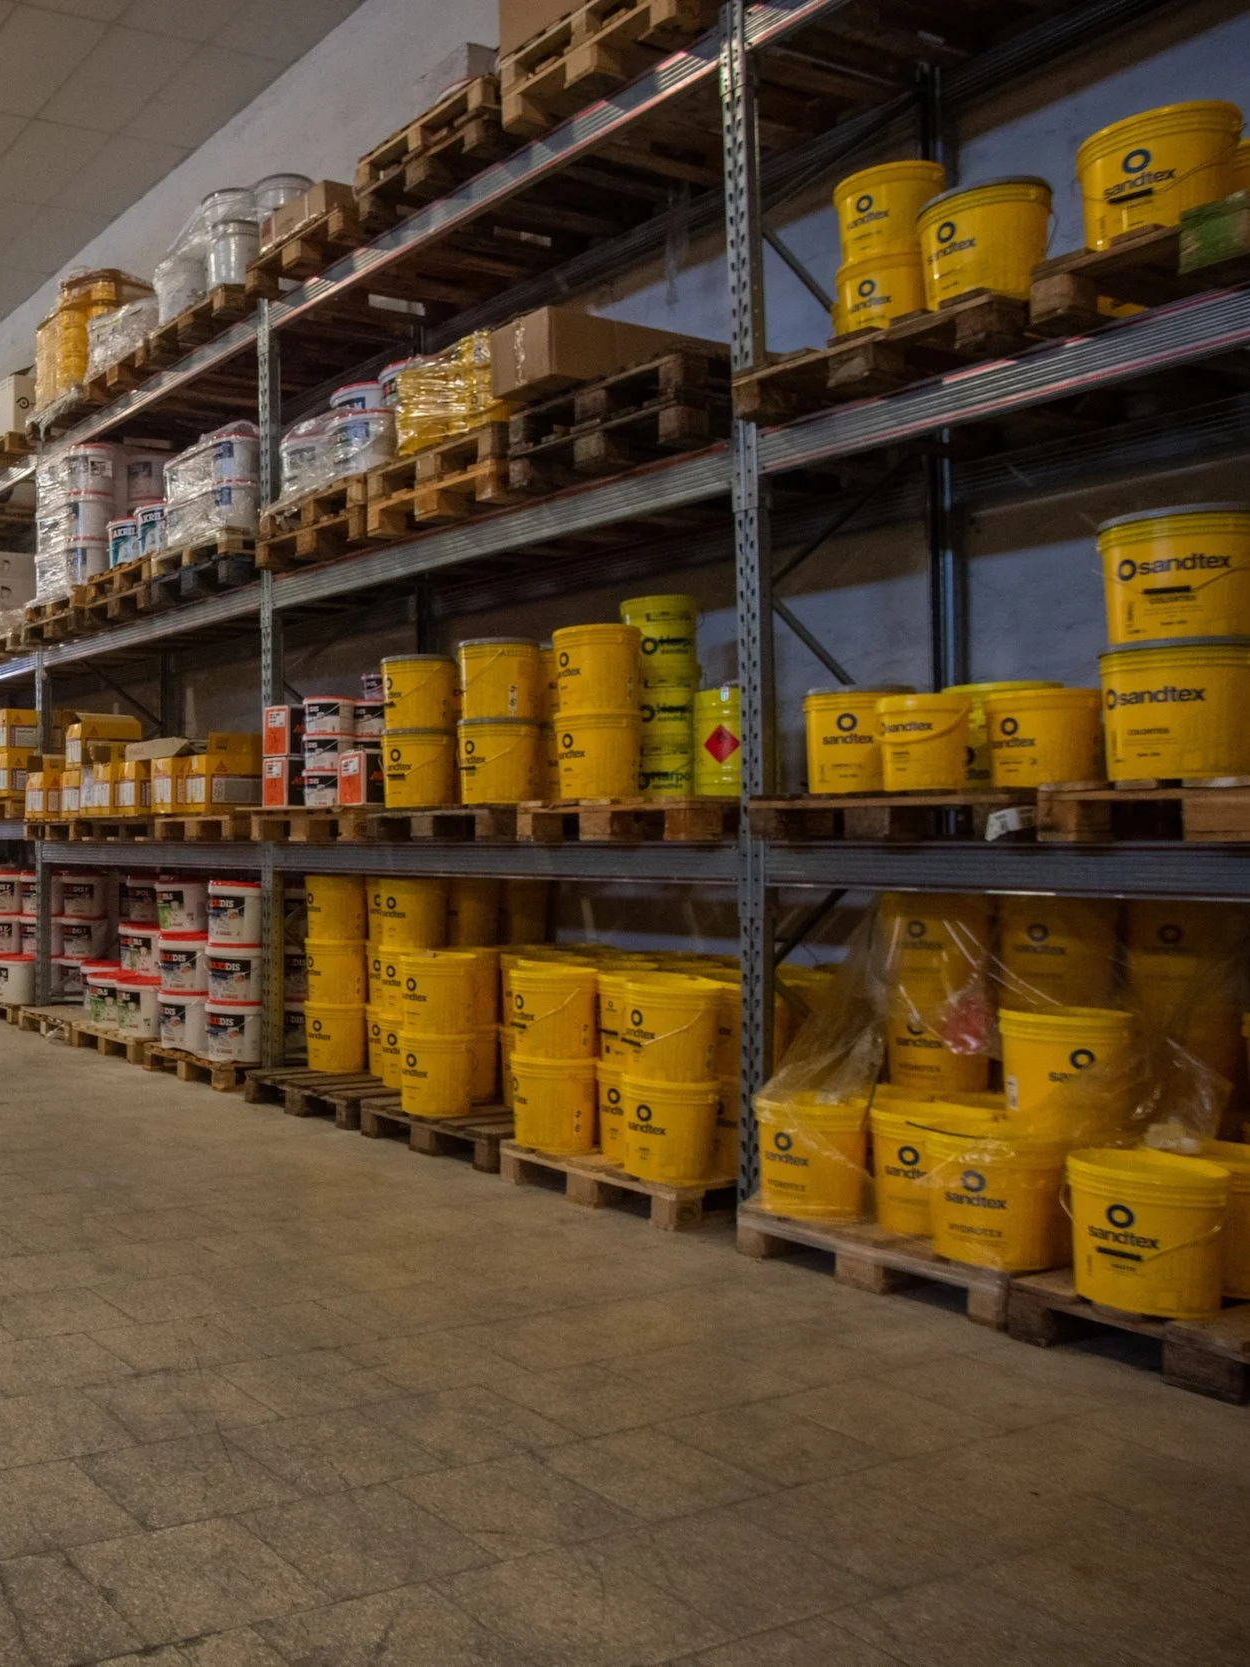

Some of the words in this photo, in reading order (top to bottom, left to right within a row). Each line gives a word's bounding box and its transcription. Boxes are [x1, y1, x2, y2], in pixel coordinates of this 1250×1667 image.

[1103, 167, 1176, 201] sandtex
[1139, 551, 1231, 575] sandtex
[1119, 685, 1207, 706] sandtex
[883, 720, 934, 735] sandtex
[821, 733, 875, 746] sandtex
[895, 1036, 944, 1049] sandtex
[764, 1151, 810, 1167] sandtex
[944, 1191, 1007, 1210] sandtex
[1087, 1224, 1160, 1251] sandtex
